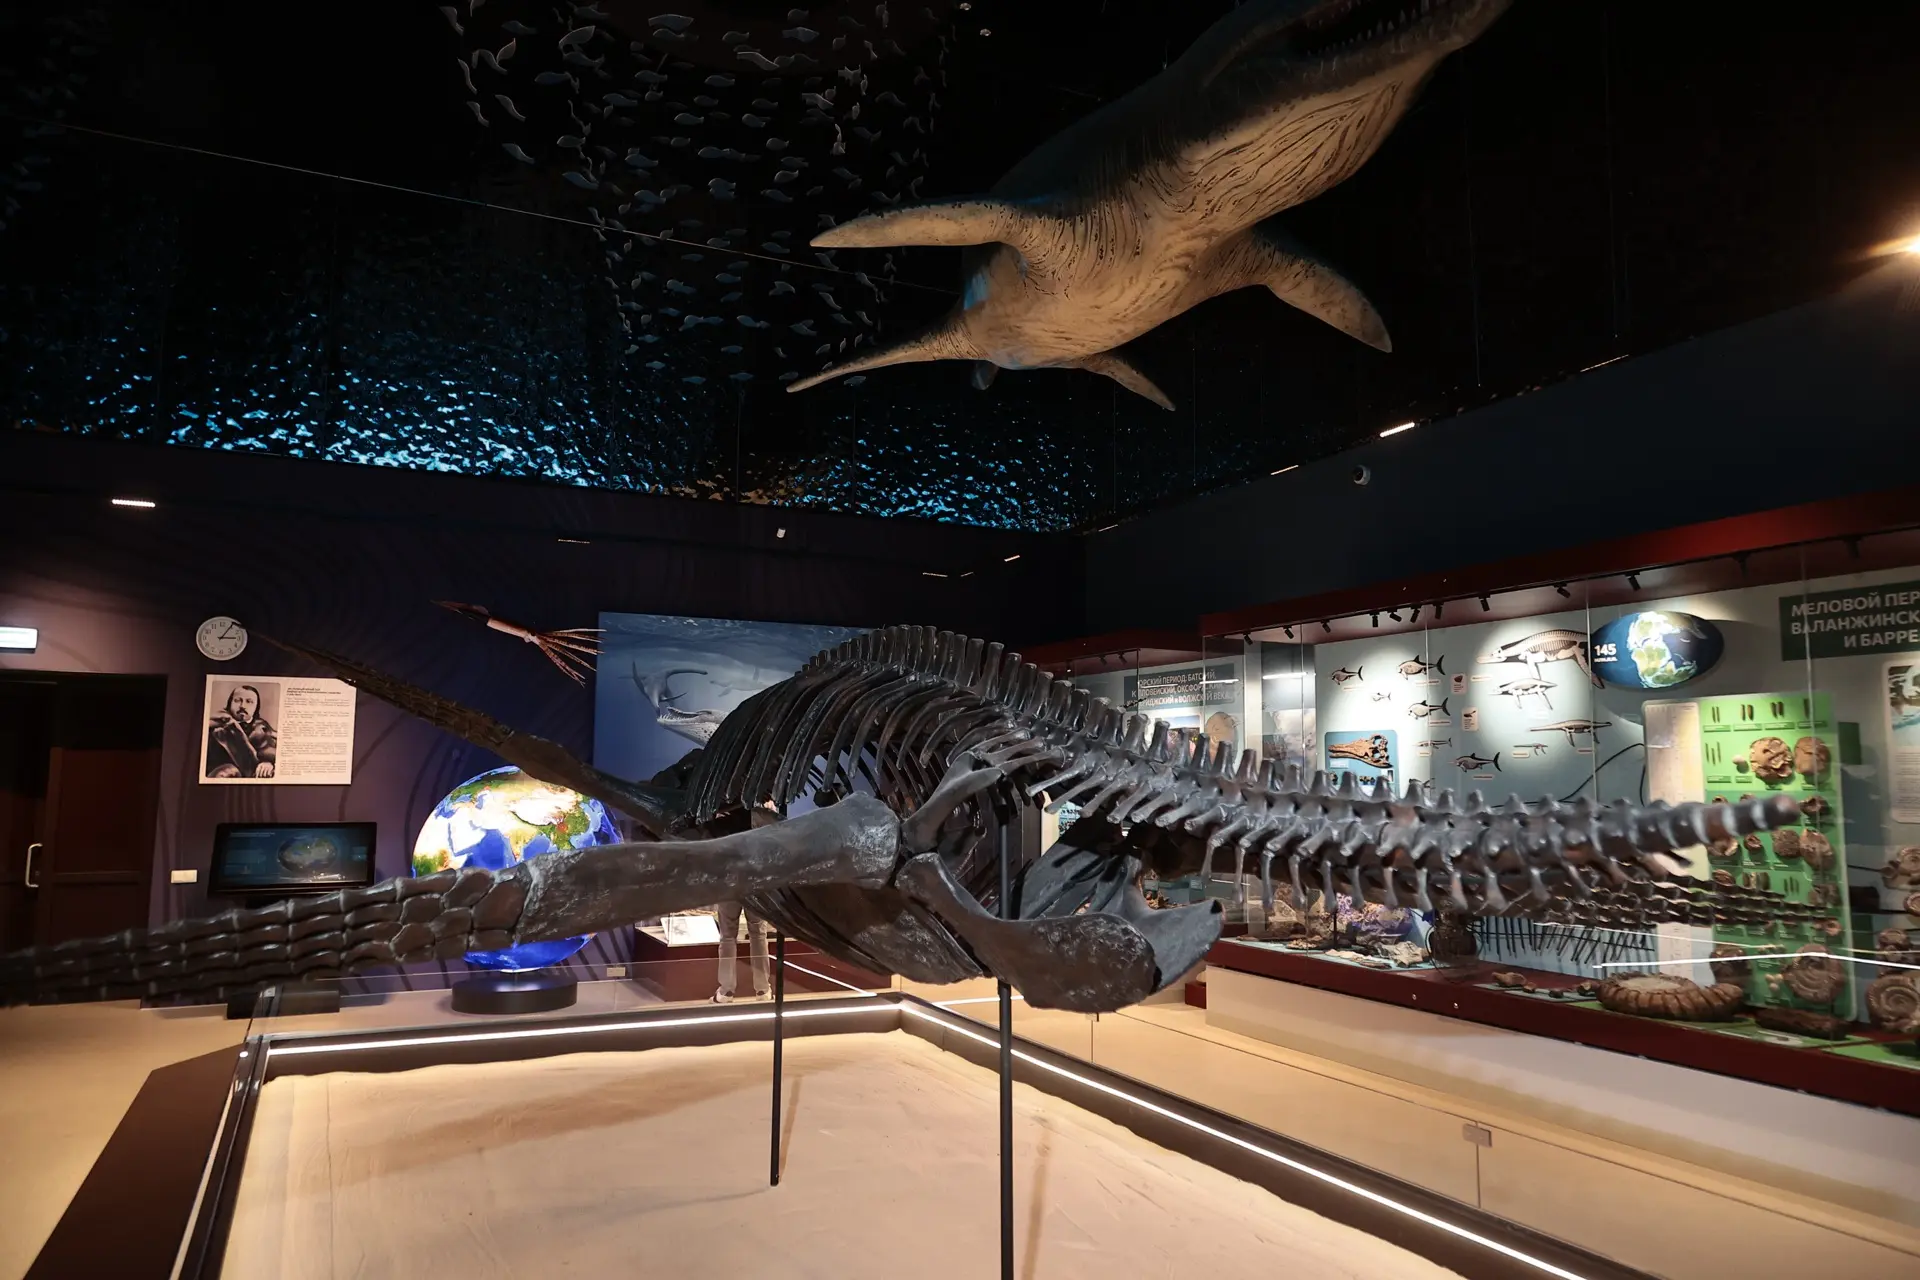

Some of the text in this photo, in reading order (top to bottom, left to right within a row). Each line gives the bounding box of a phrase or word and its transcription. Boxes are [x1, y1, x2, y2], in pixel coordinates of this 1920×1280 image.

[1791, 591, 1920, 617] МЕЛОВОЙ ПЕР
[1791, 610, 1920, 635] ВАЛАНЖИНСК
[1594, 643, 1617, 656] 145
[1843, 629, 1919, 648] И БАРРЕ
